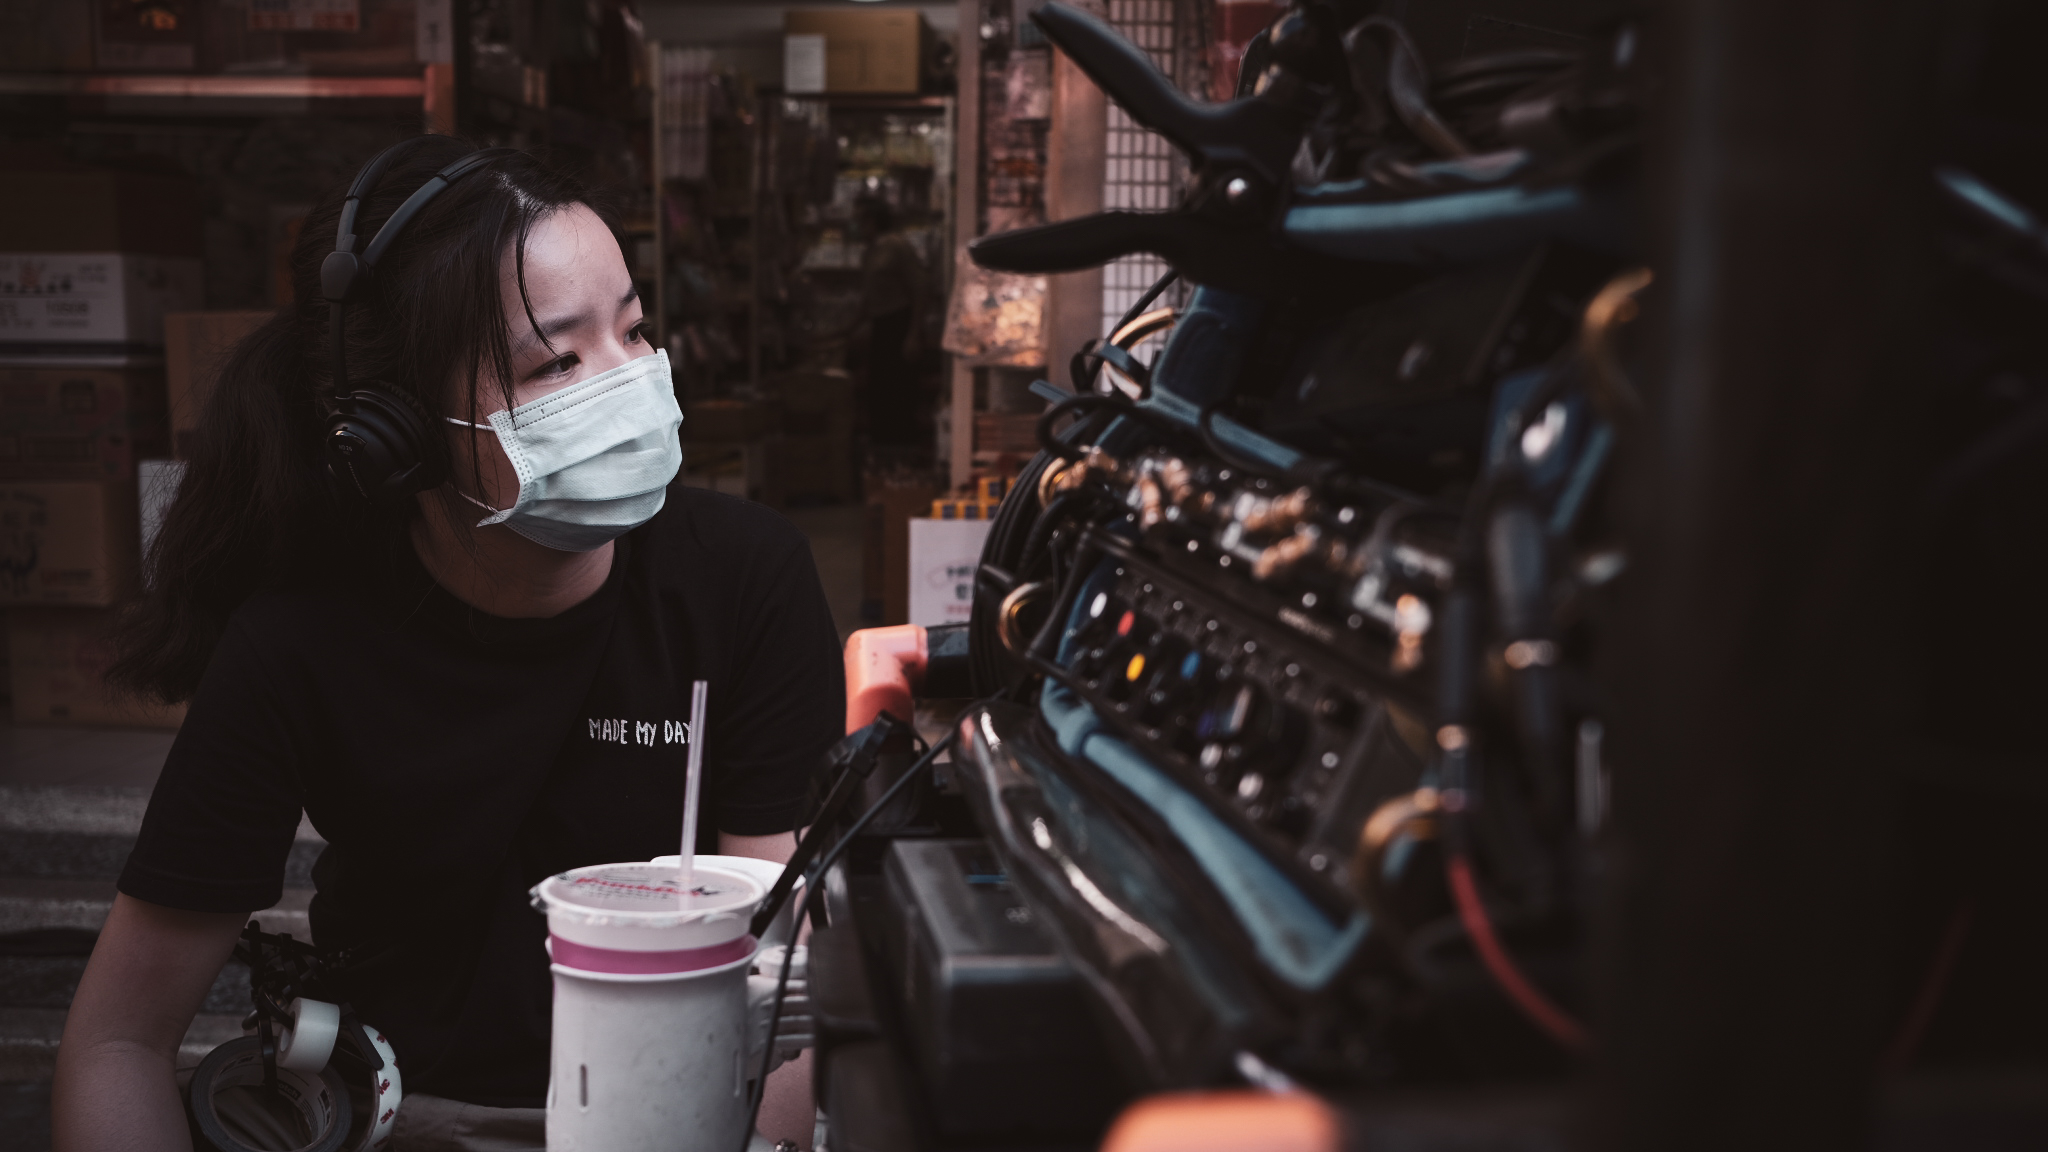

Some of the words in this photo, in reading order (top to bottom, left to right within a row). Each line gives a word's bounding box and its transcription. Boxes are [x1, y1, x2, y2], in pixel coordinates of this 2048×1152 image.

[588, 718, 628, 745] MADE
[635, 720, 657, 748] MY
[664, 719, 692, 745] DAY
[278, 1083, 299, 1099] otch
[379, 1108, 395, 1125] 3M
